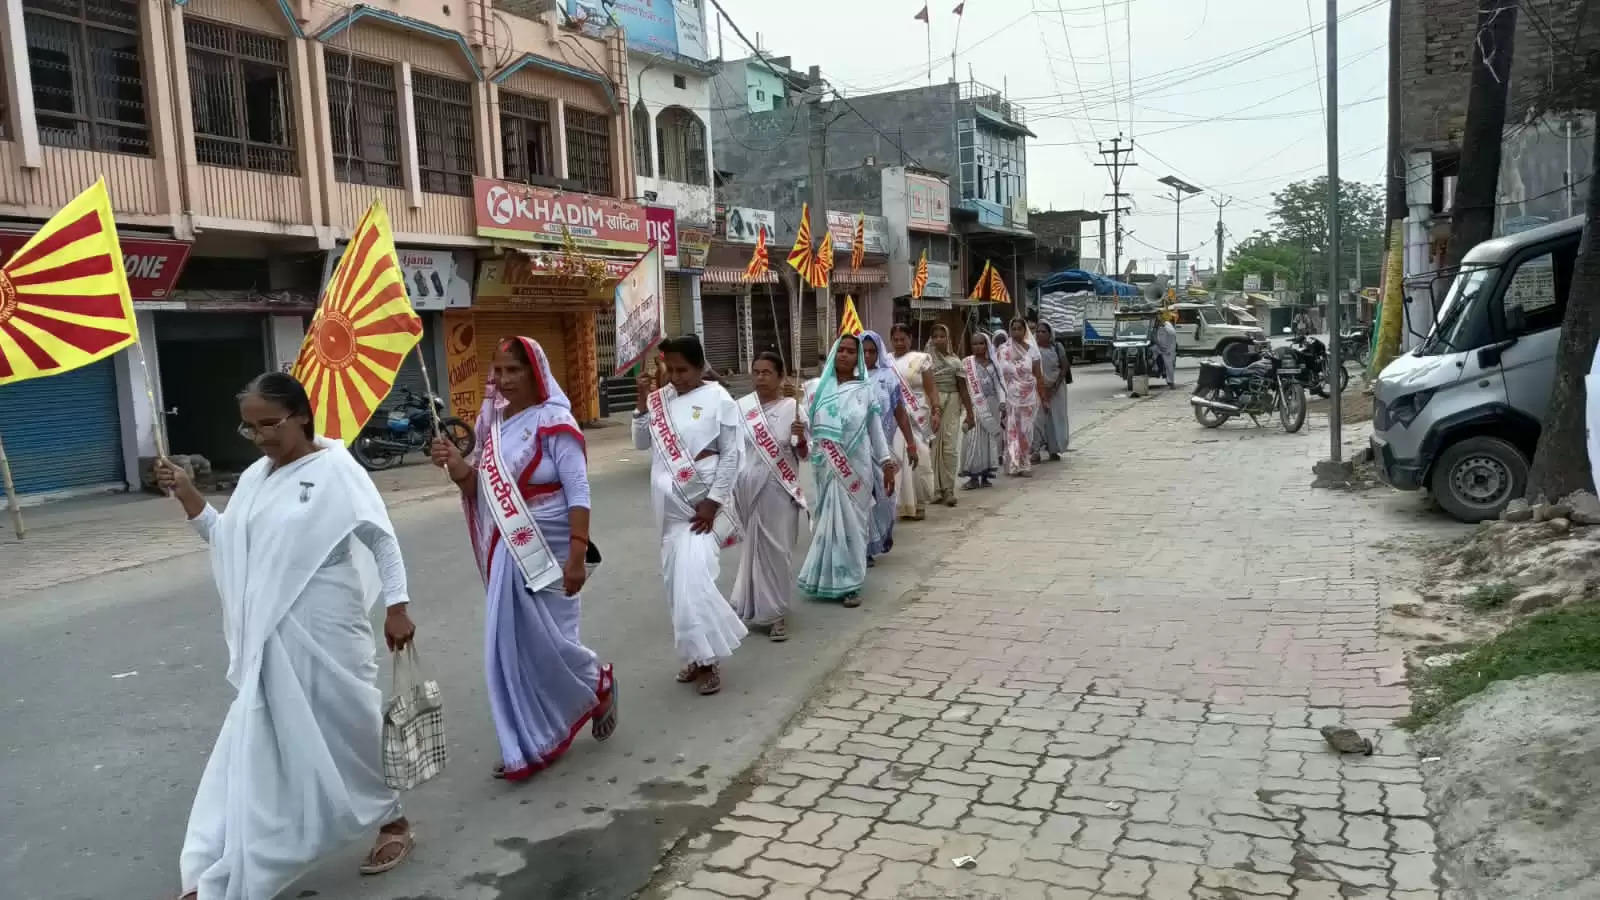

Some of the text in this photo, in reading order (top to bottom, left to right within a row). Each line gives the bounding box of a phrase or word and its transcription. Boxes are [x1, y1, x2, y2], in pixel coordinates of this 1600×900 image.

[514, 195, 604, 228] KHADIM
[606, 213, 640, 233] खादिम
[123, 254, 168, 279] ONE
